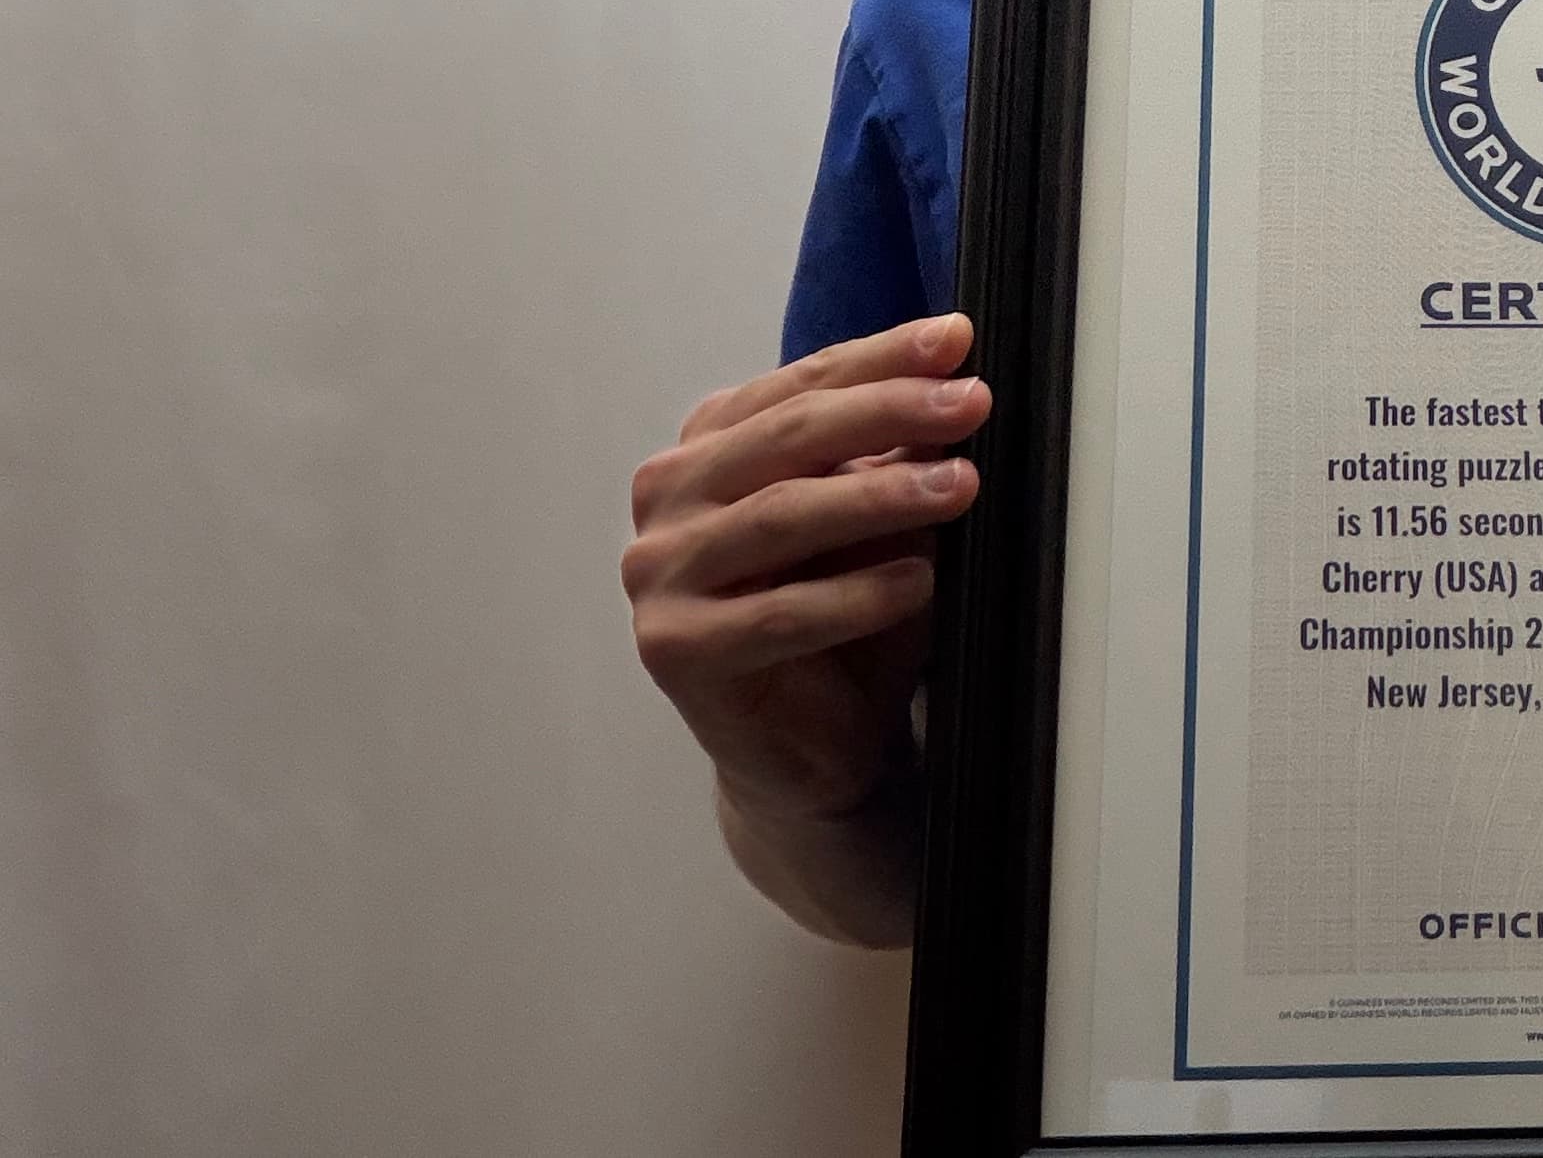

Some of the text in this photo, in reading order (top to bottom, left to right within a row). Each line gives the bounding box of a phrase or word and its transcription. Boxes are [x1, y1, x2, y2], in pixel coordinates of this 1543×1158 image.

[1365, 397, 1415, 427] The
[1426, 397, 1527, 427] fastest
[1328, 451, 1447, 488] rotating
[1338, 507, 1361, 537] is
[1372, 505, 1447, 537] 11.56
[1322, 561, 1423, 599] Cherry
[1435, 561, 1517, 599] (USA)
[1300, 618, 1513, 657] Championship
[1367, 676, 1427, 708] New
[1438, 675, 1541, 713] Jersey,
